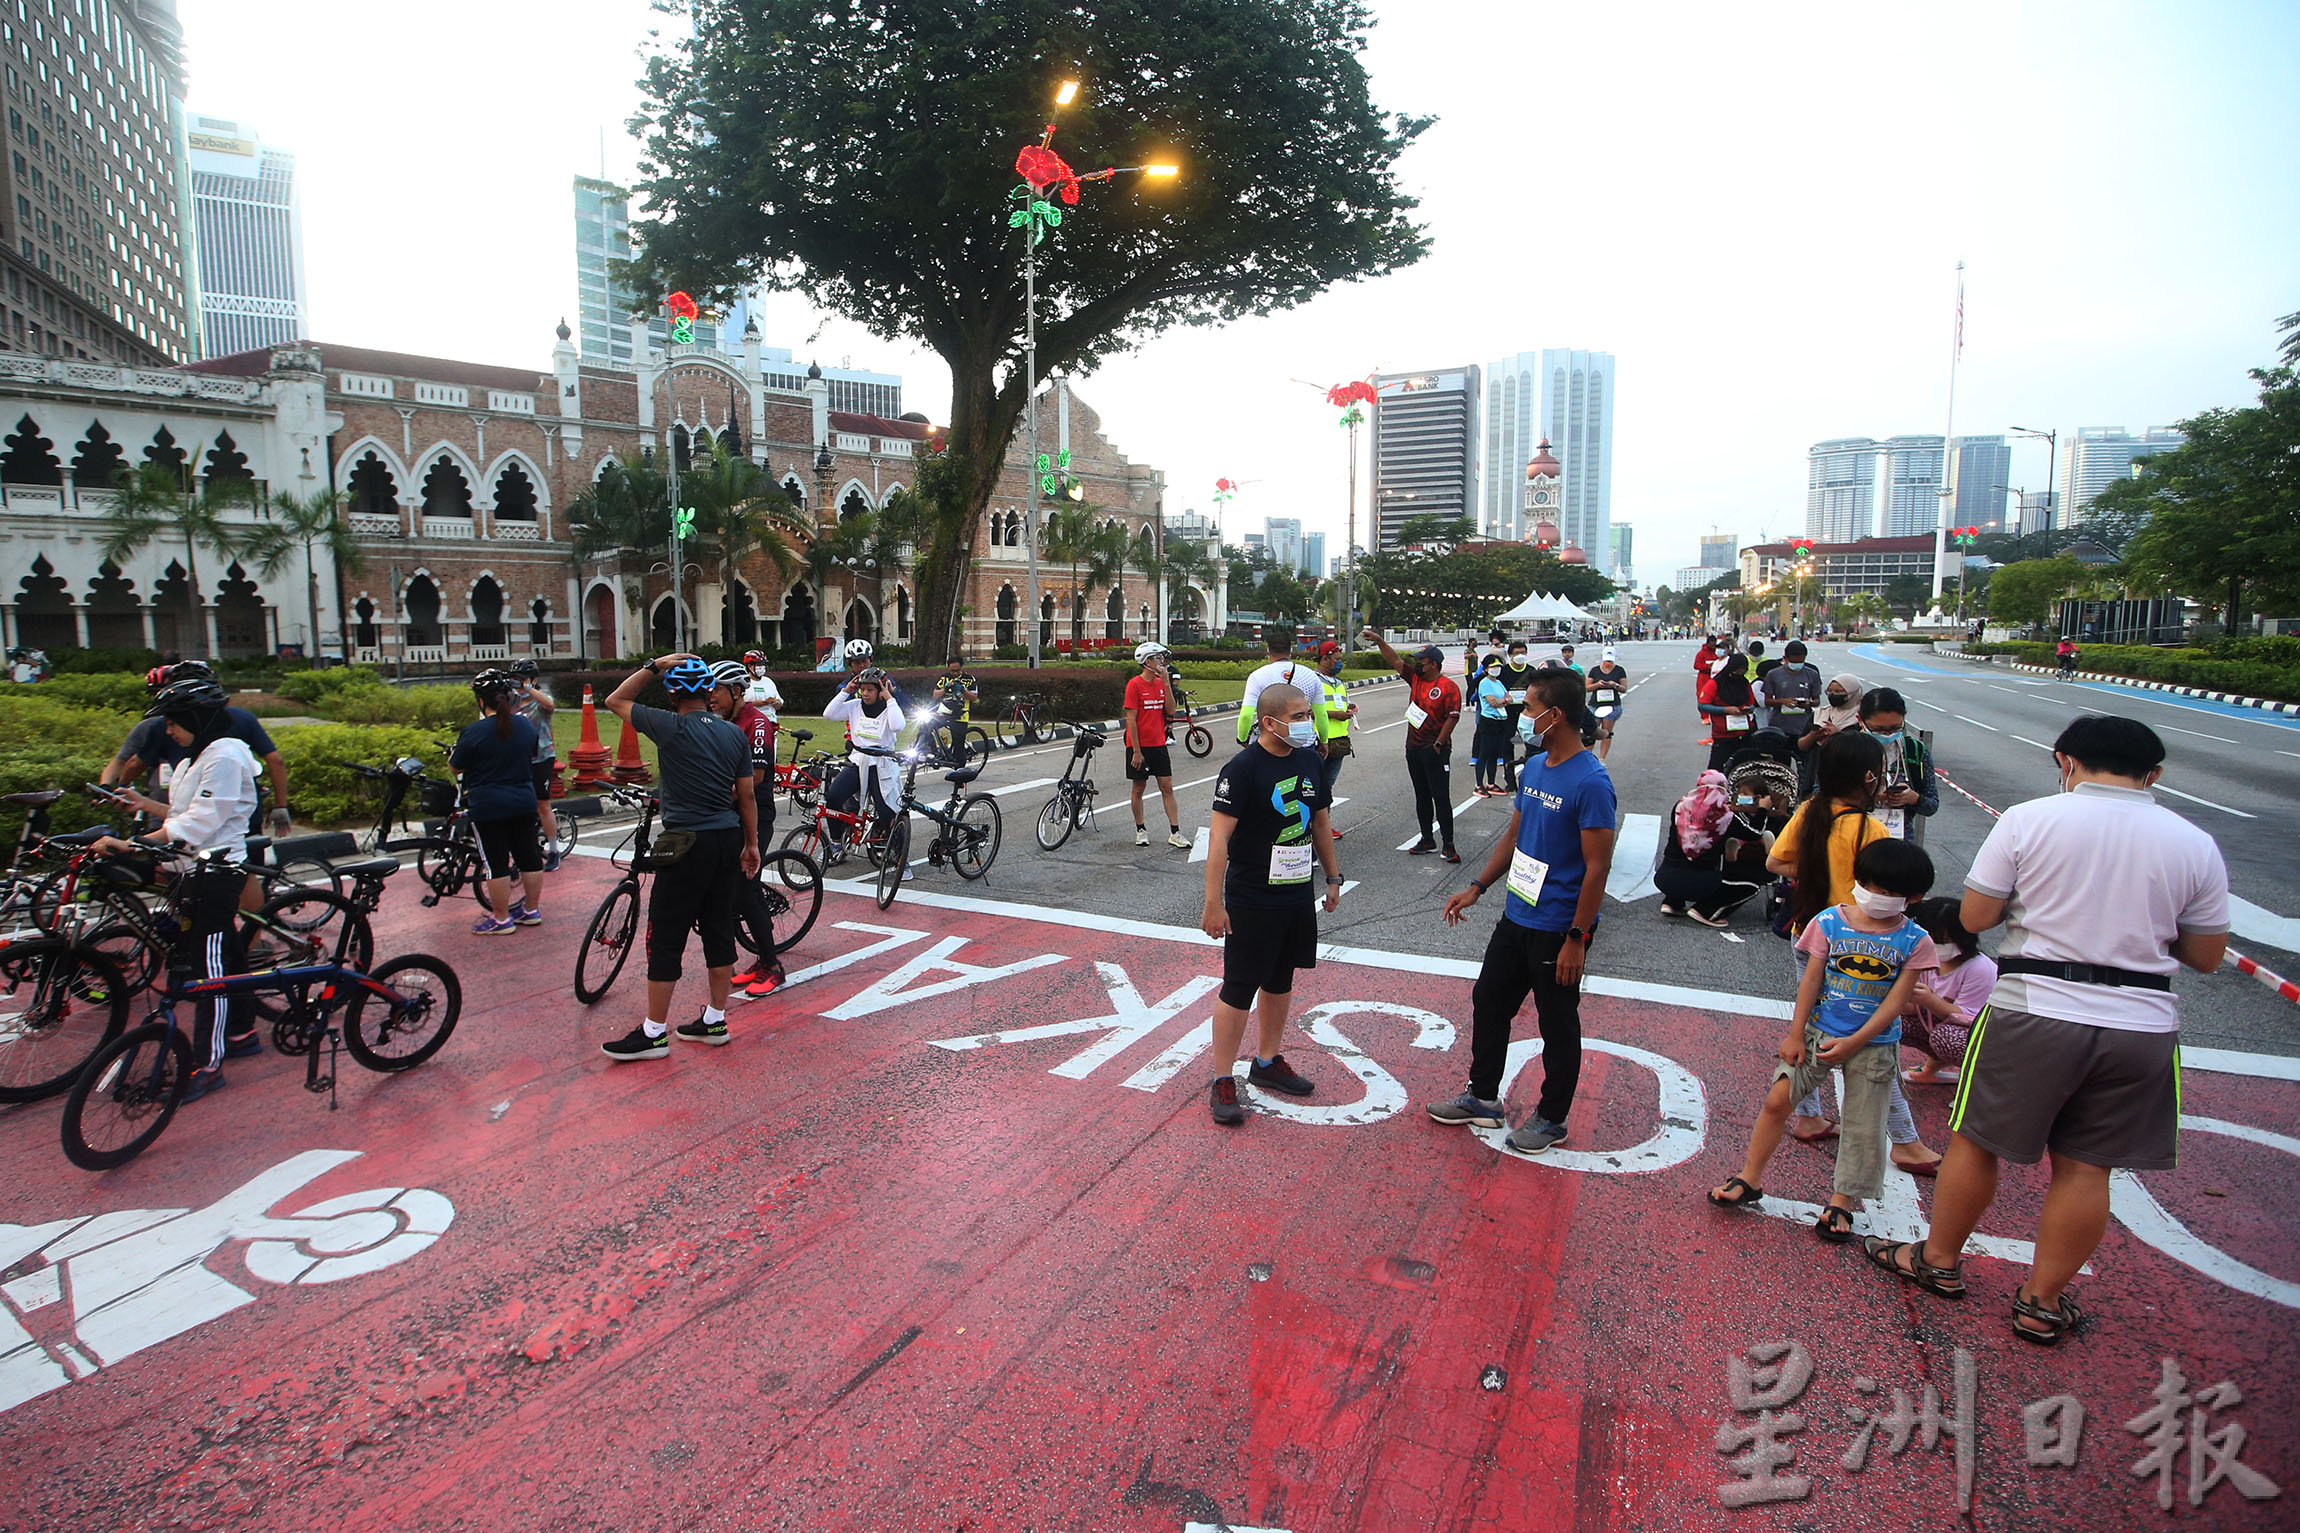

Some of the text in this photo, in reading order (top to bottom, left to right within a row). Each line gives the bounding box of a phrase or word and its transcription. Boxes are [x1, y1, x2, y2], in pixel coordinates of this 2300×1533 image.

[189, 136, 239, 151] aybank
[1417, 383, 1439, 391] BANK
[753, 718, 766, 755] INEOS
[1829, 939, 1903, 966] ATMA
